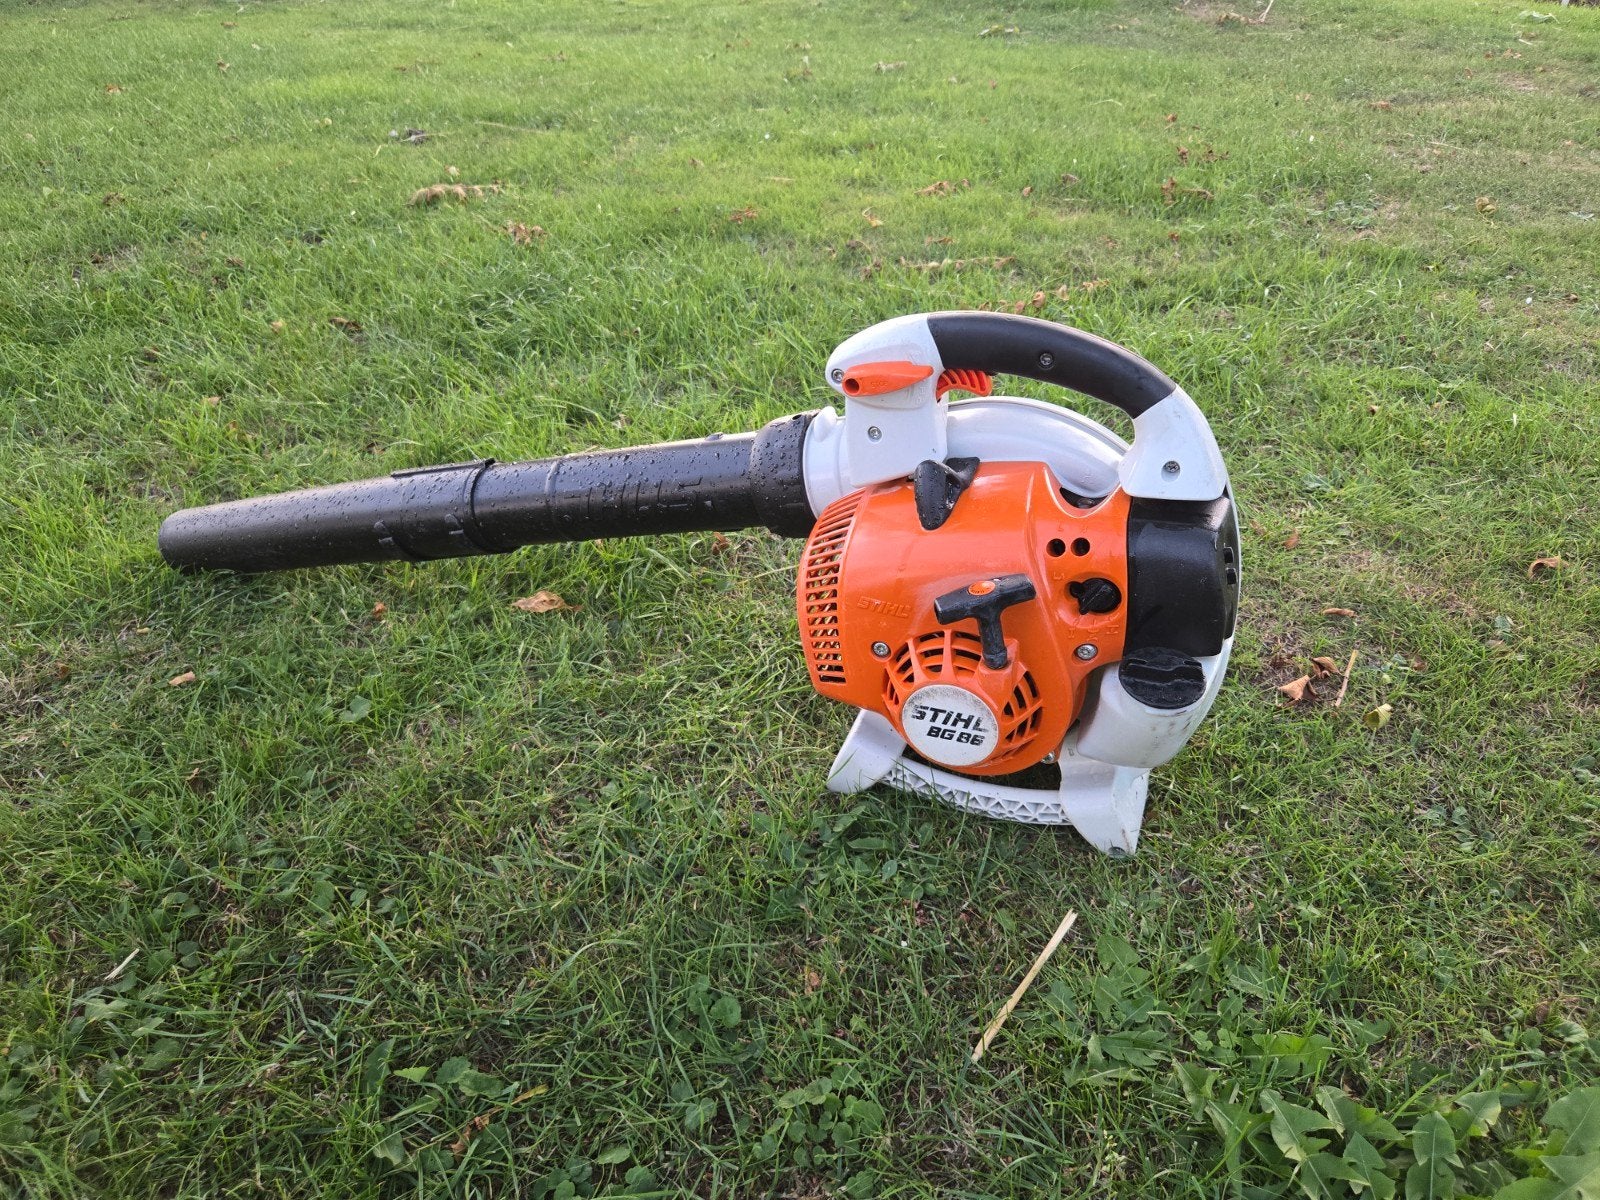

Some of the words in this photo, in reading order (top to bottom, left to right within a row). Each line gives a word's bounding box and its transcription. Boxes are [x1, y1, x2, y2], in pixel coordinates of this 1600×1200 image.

[857, 596, 911, 618] STIHL
[912, 705, 988, 732] STIHL
[927, 726, 955, 740] BG
[956, 731, 985, 746] 86
